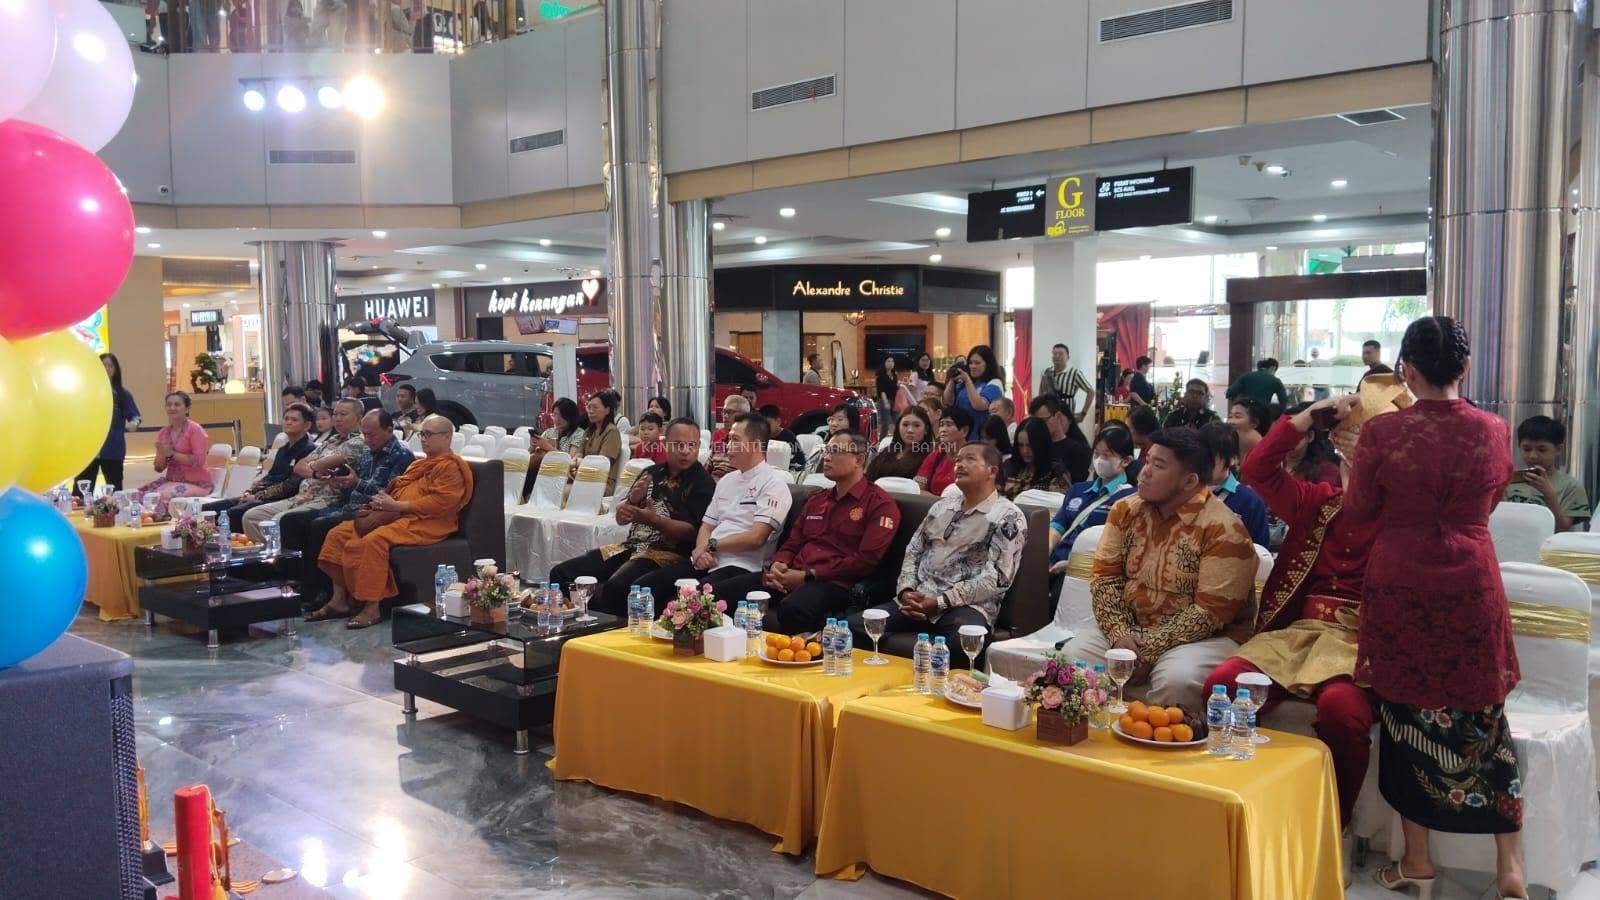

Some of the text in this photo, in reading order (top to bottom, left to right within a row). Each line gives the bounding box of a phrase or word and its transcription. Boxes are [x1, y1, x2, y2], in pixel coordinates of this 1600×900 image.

[1058, 177, 1083, 208] G
[1056, 208, 1085, 219] FLOOR
[793, 280, 904, 296] Alexandre Christie
[365, 296, 428, 320] HUAWEI
[488, 288, 584, 314] kopi kenangan
